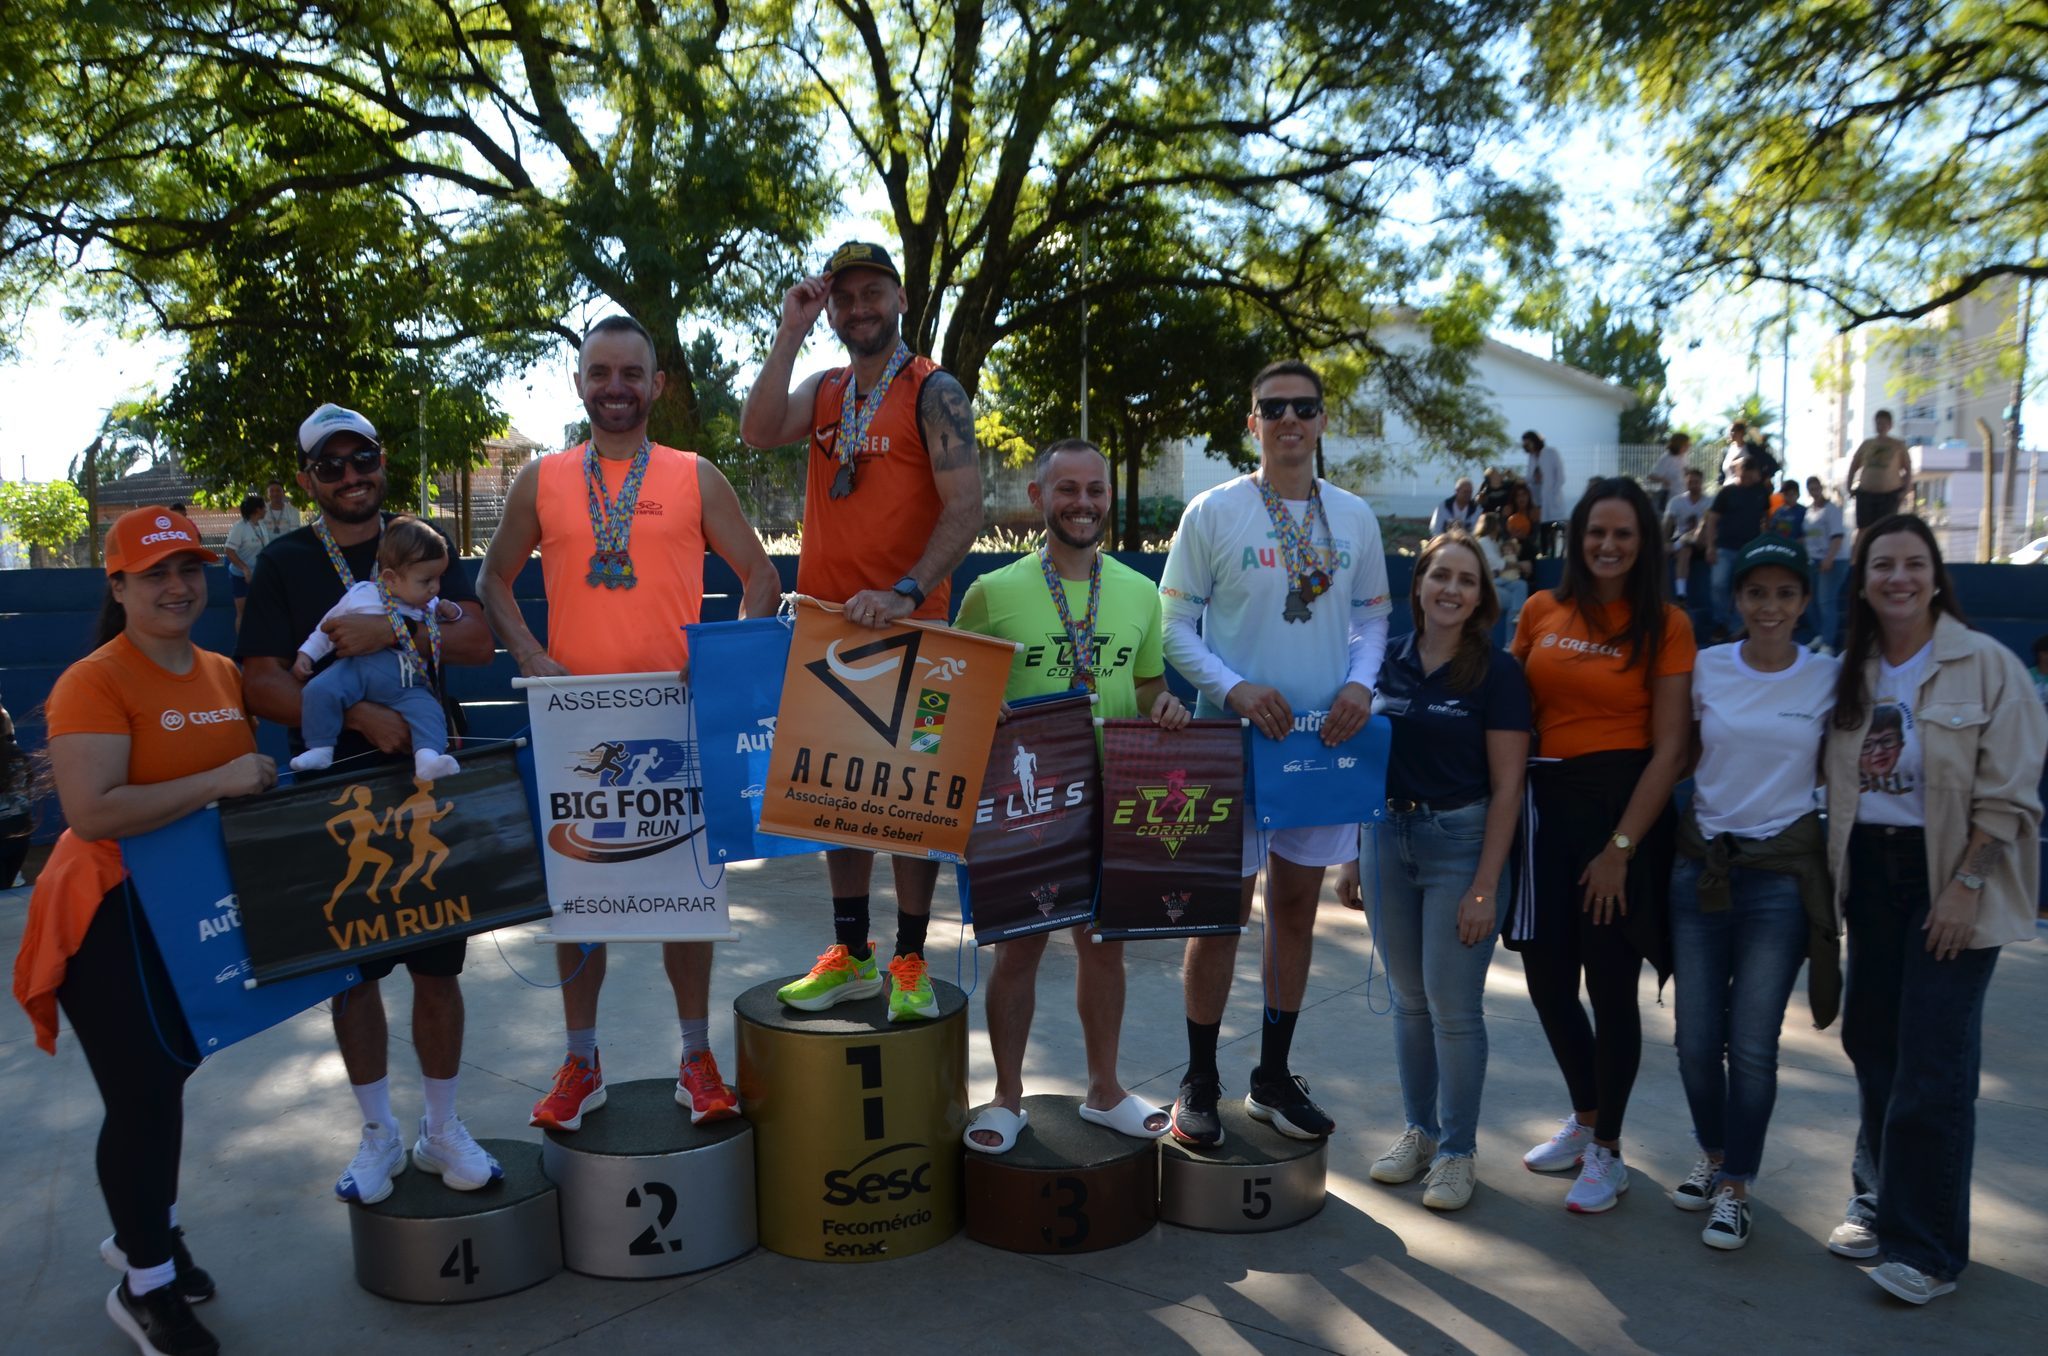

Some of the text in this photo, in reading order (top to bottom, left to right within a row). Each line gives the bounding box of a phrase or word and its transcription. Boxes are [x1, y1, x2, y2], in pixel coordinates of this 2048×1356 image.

[140, 530, 192, 545] CRESOL
[1560, 637, 1623, 657] CRESOL
[548, 687, 686, 711] ASSESSORI
[188, 707, 245, 725] CRESOL
[791, 747, 967, 810] ACORSEB
[550, 791, 608, 820] BIG
[785, 786, 958, 828] Associação dos Corredores
[976, 781, 1085, 824] ELES
[1113, 798, 1233, 825] ELAS
[637, 820, 680, 837] RUN
[814, 814, 924, 843] de Rua de Seberi
[1136, 824, 1210, 836] CORREM
[563, 894, 716, 914] #ÉSÓNÃOPARAR
[328, 895, 472, 951] VM RUN
[846, 1045, 884, 1140] 1
[1040, 1177, 1090, 1249] 3
[1242, 1177, 1271, 1220] 5
[626, 1182, 682, 1256] 2
[823, 1209, 932, 1235] Fecomércio
[440, 1238, 480, 1284] 4
[825, 1240, 885, 1257] Senac
